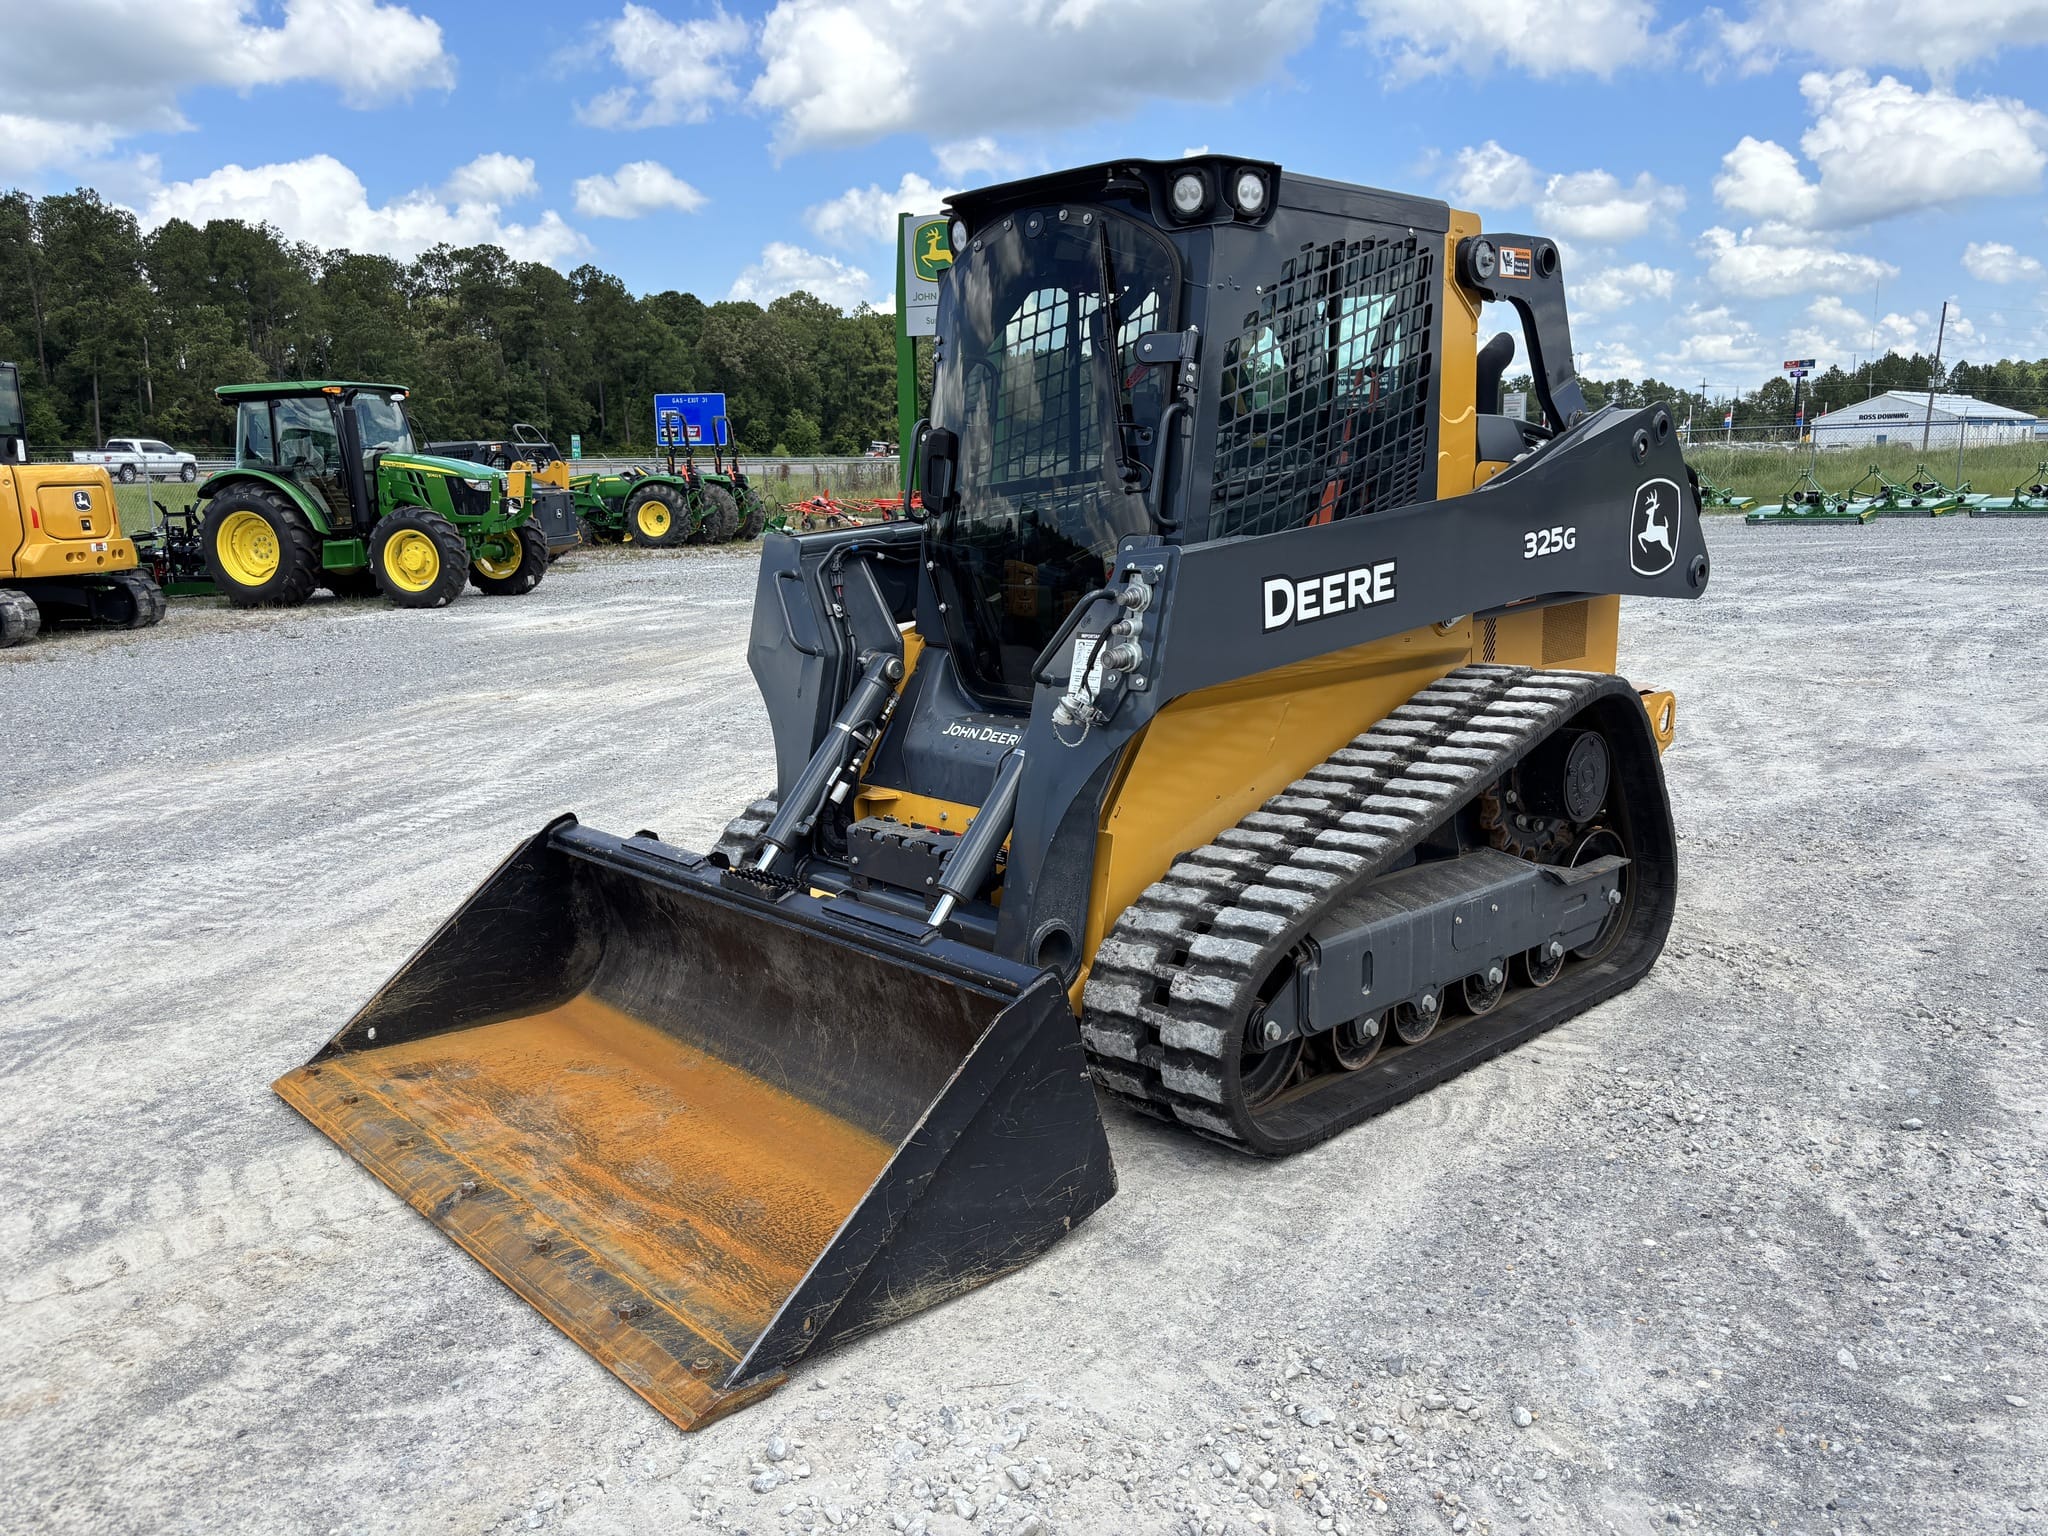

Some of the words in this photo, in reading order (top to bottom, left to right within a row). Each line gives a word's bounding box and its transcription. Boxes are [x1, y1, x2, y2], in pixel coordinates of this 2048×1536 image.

[913, 292, 937, 301] JOHN
[1524, 526, 1576, 559] 325G
[1263, 561, 1396, 630] DEERE
[942, 722, 980, 740] JOHN
[979, 727, 1021, 746] DEER
